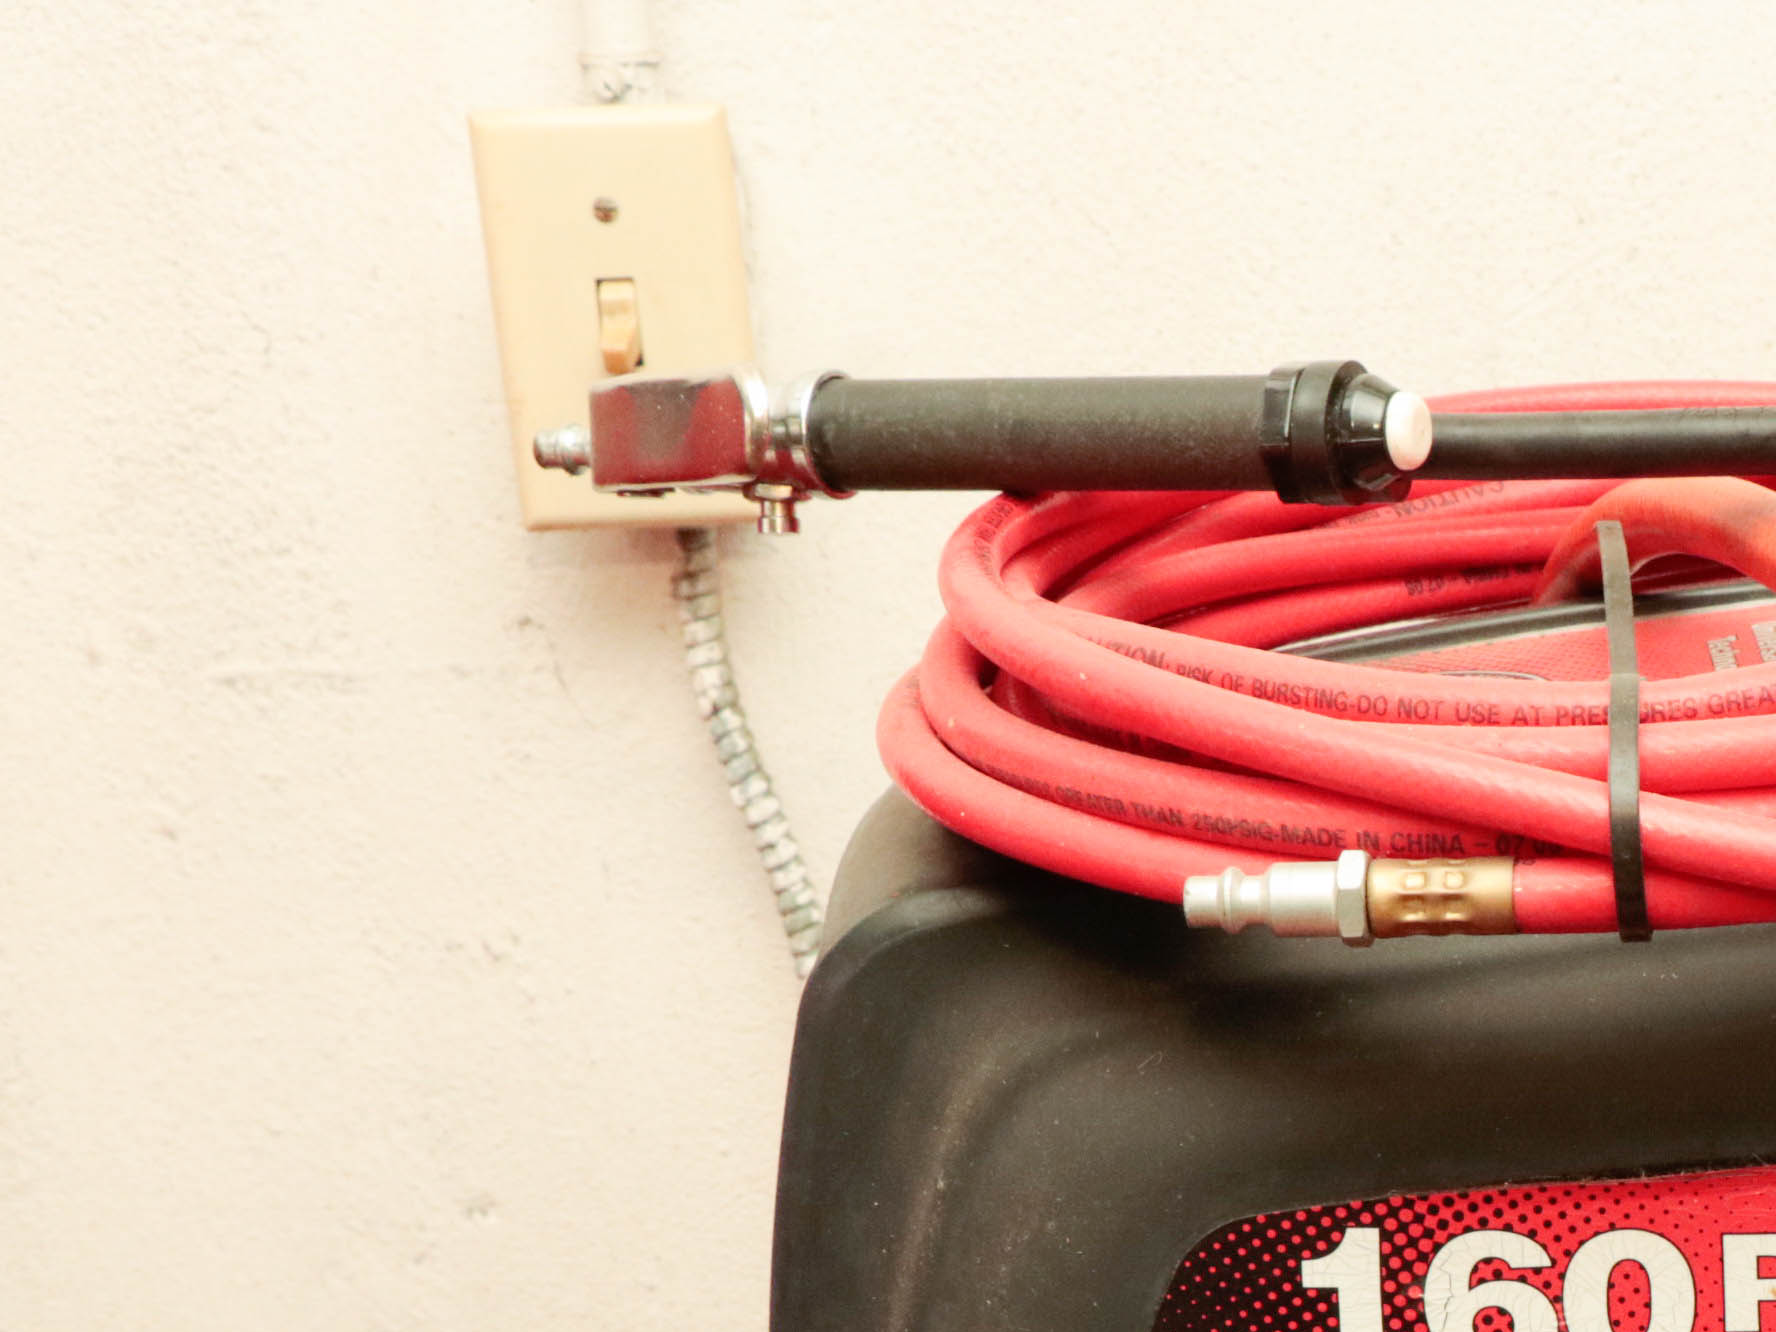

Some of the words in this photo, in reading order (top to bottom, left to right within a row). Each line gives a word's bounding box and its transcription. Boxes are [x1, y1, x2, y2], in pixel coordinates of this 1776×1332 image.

[1220, 672, 1244, 693] OF
[1397, 697, 1444, 721] NOT
[1456, 704, 1500, 725] USE
[1511, 706, 1543, 726] AT
[1356, 830, 1380, 851] IN
[1389, 832, 1465, 854] CHINA
